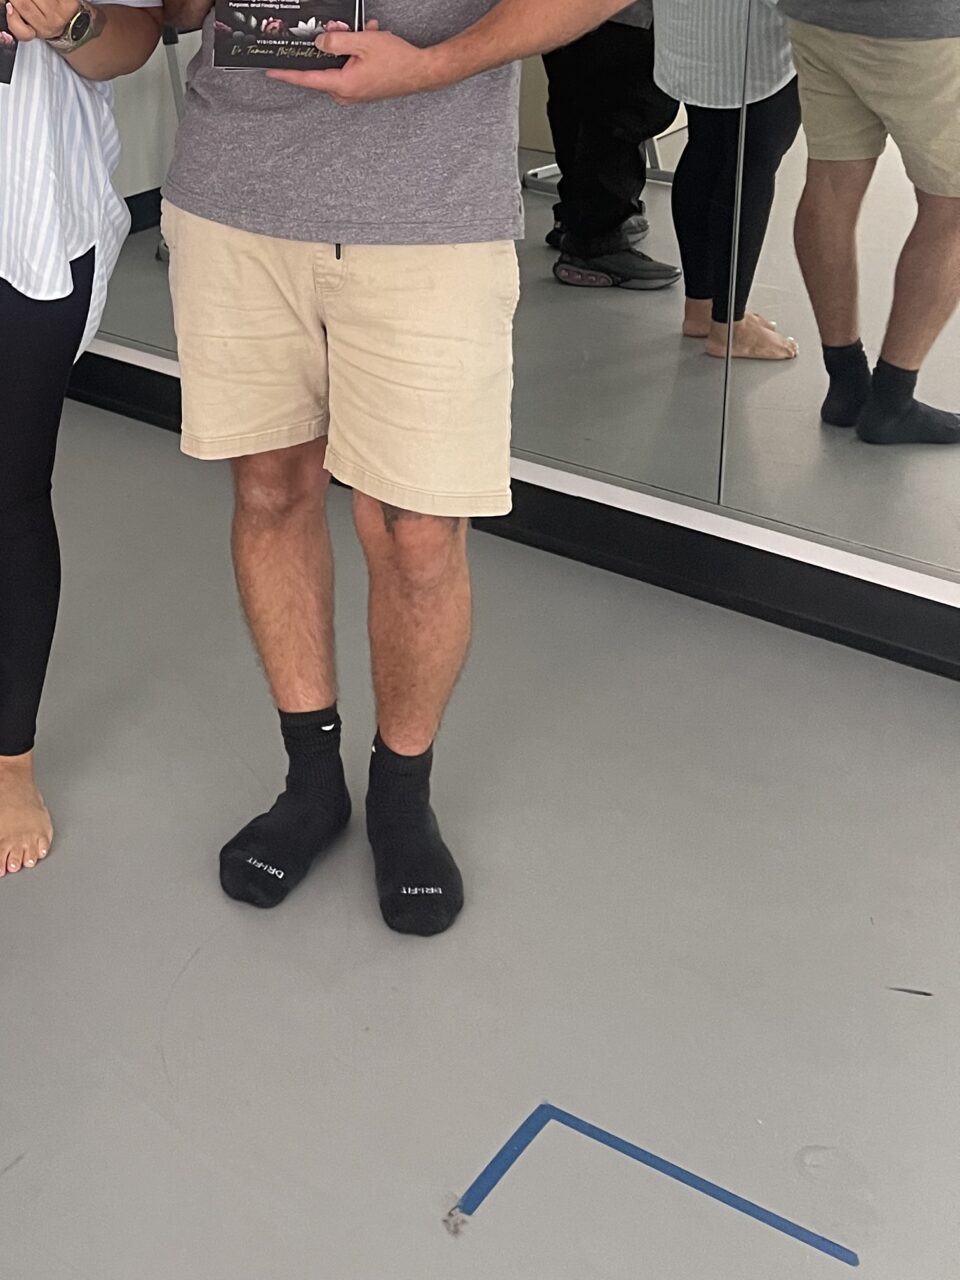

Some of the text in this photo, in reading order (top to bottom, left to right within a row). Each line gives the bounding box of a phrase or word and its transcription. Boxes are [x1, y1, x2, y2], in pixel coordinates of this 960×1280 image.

[247, 45, 274, 55] Tamara
[246, 857, 285, 879] DRI-FIT
[400, 887, 443, 895] DRI-FIT
